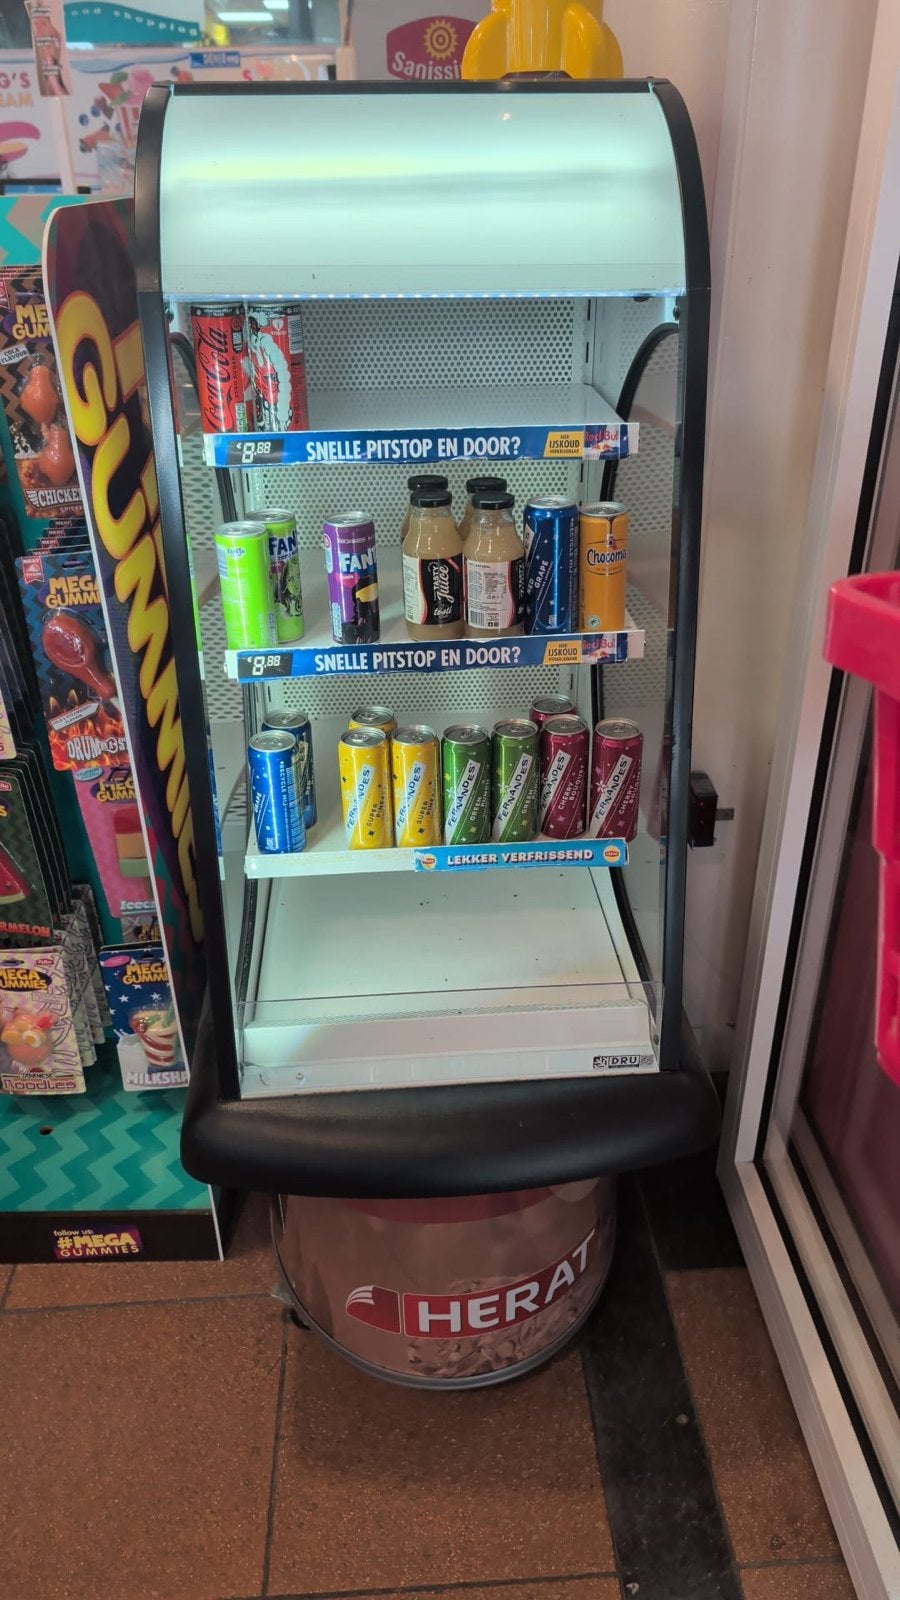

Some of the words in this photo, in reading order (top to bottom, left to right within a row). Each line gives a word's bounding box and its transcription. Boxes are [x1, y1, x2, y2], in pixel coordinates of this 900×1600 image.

[306, 440, 361, 461] SNELLE
[367, 437, 433, 459] PITSTOP
[437, 437, 459, 457] EN
[463, 435, 521, 457] DOOR?
[534, 560, 549, 588] GRAPE
[315, 653, 368, 672] SNELLE
[373, 650, 436, 669] PITSTOP
[441, 649, 465, 667] EN
[466, 647, 521, 665] DOOR?
[448, 765, 475, 827] FERNANDES
[498, 759, 528, 821] FERNANDES
[558, 781, 574, 810] CHERRY
[595, 759, 627, 820] FERNANDES
[618, 784, 634, 815] CHERRY
[448, 853, 498, 866] LEKKER
[501, 849, 593, 864] VERFRISSEND
[57, 1232, 137, 1250] #MEGA
[60, 1245, 140, 1257] GUMMIES
[418, 1227, 596, 1333] HERAT
